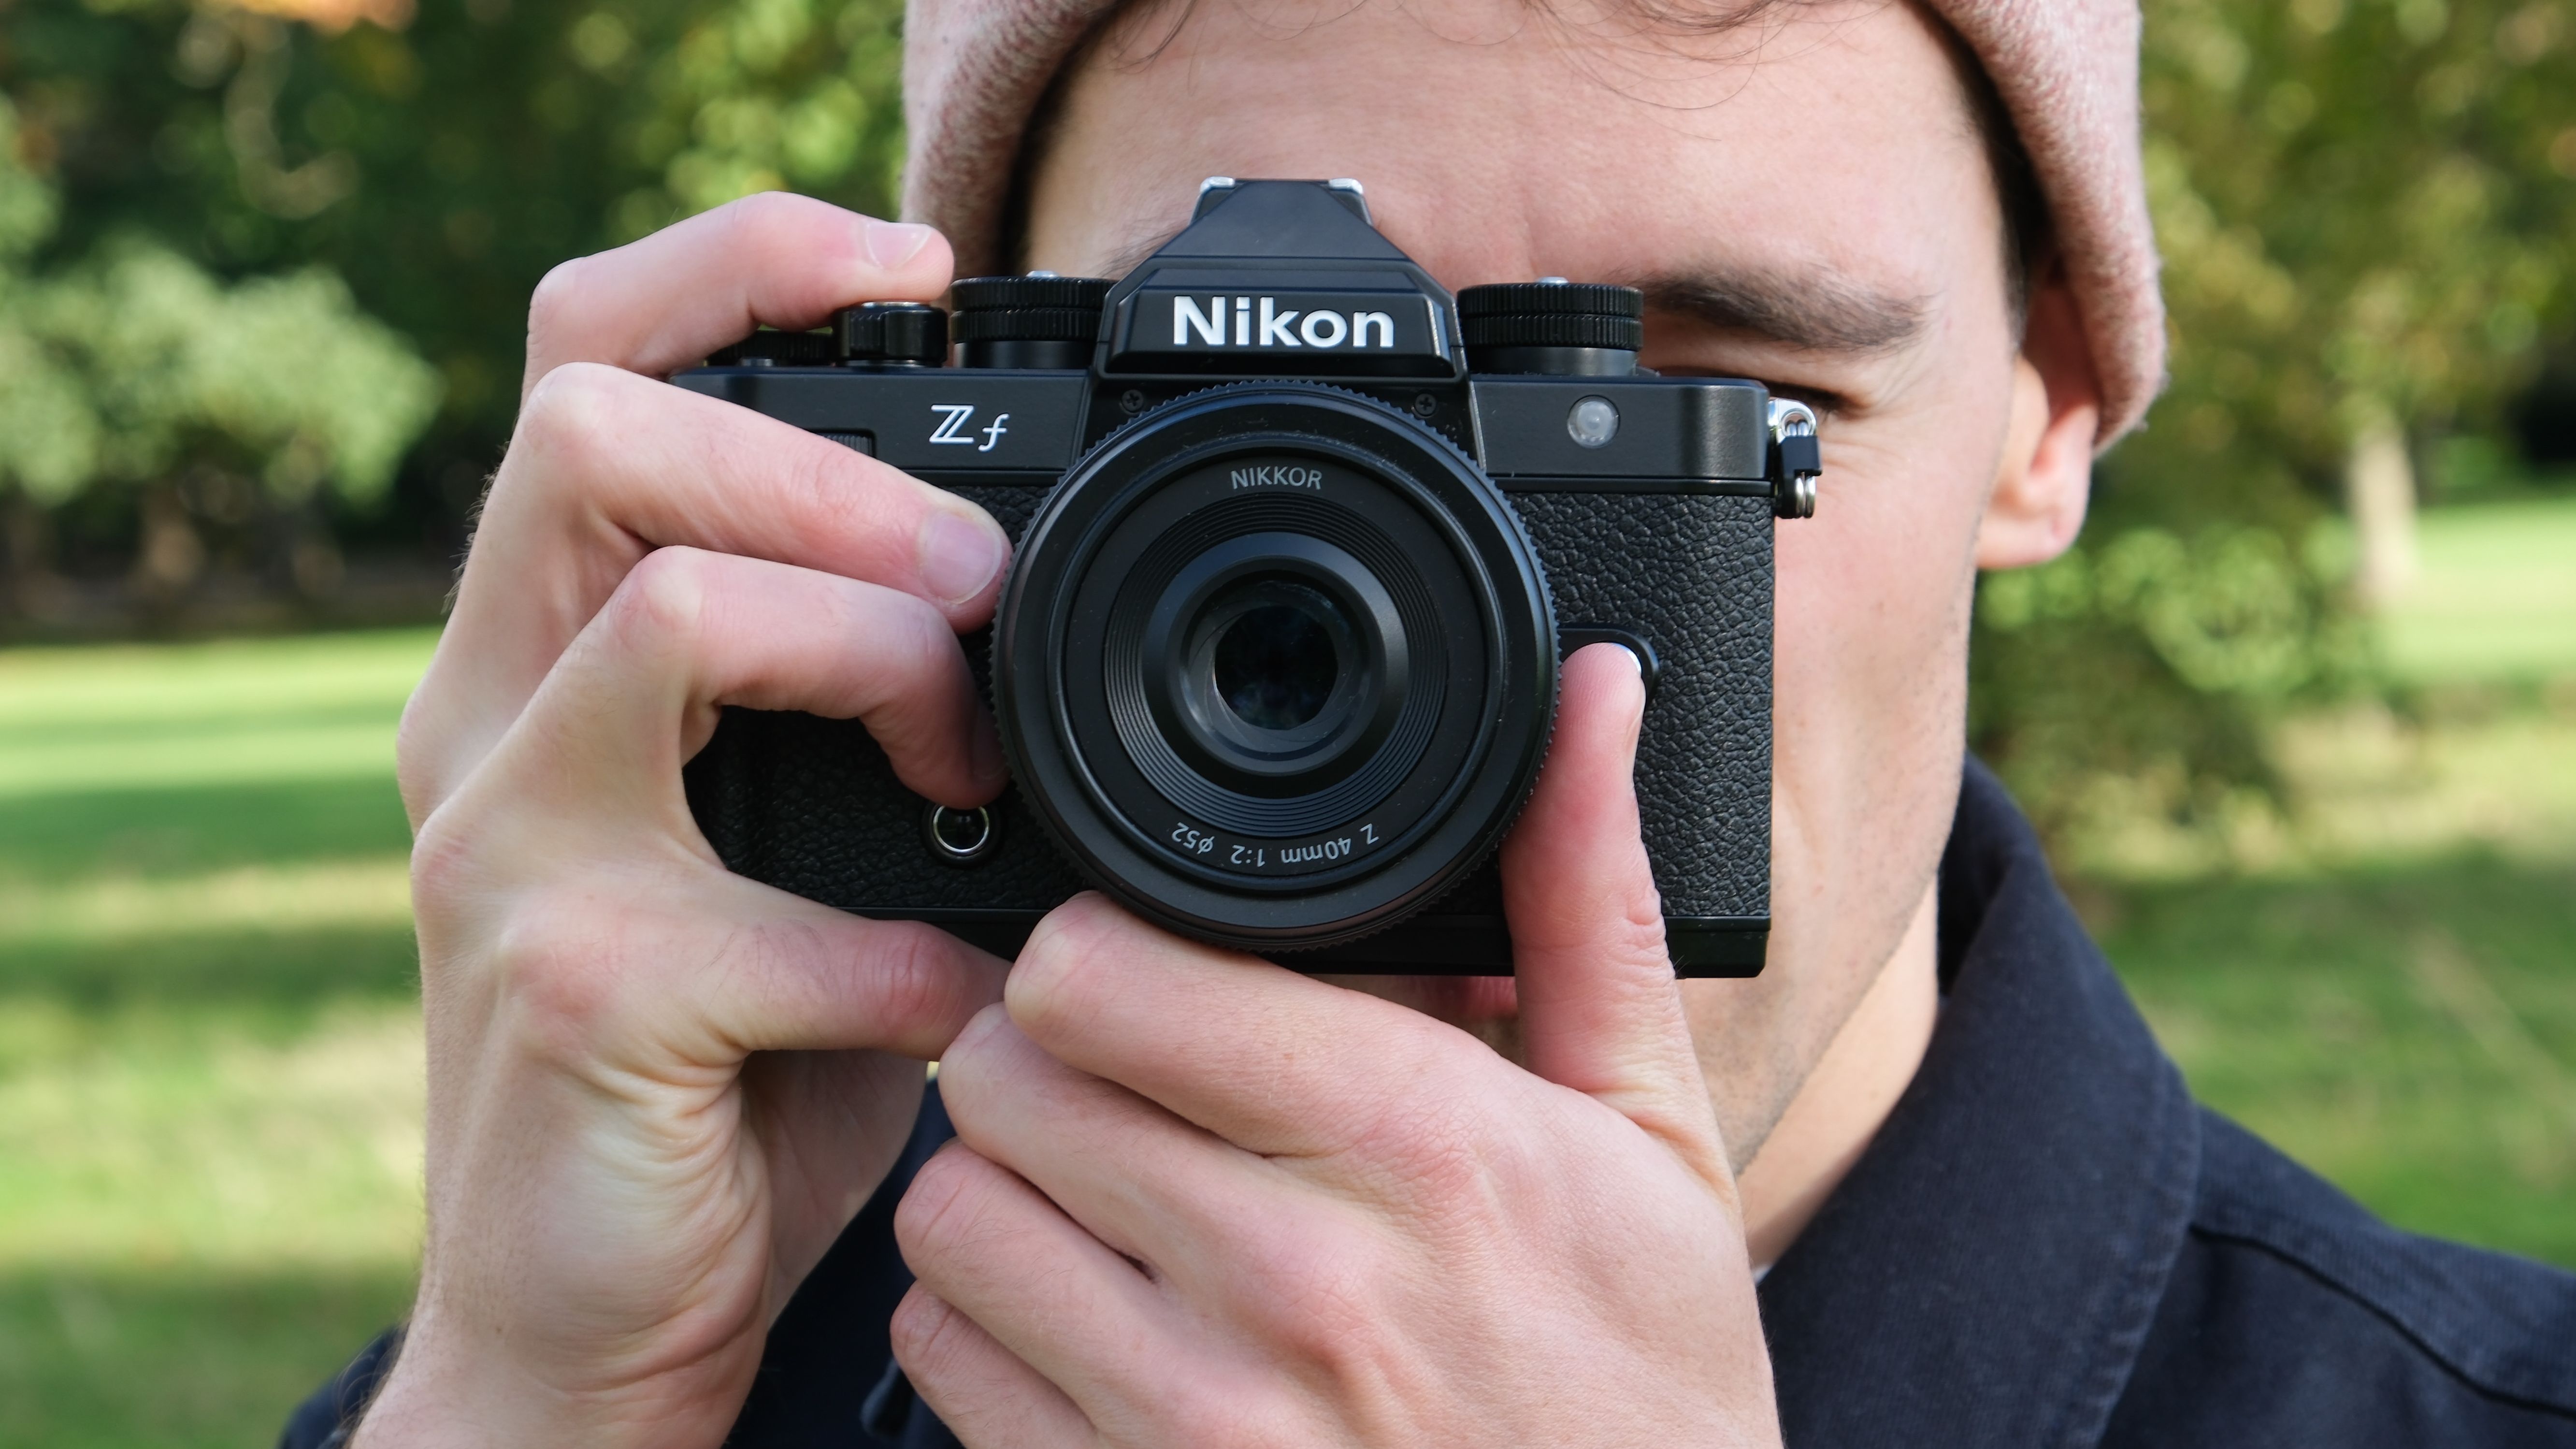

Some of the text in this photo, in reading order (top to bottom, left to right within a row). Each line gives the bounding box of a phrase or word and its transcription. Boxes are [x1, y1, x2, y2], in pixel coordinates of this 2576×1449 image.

[1173, 296, 1394, 348] Nikon
[1231, 466, 1322, 490] NIKKOR
[1359, 823, 1380, 845] Z
[1230, 845, 1266, 867] 1:2
[1281, 837, 1351, 864] 40mm
